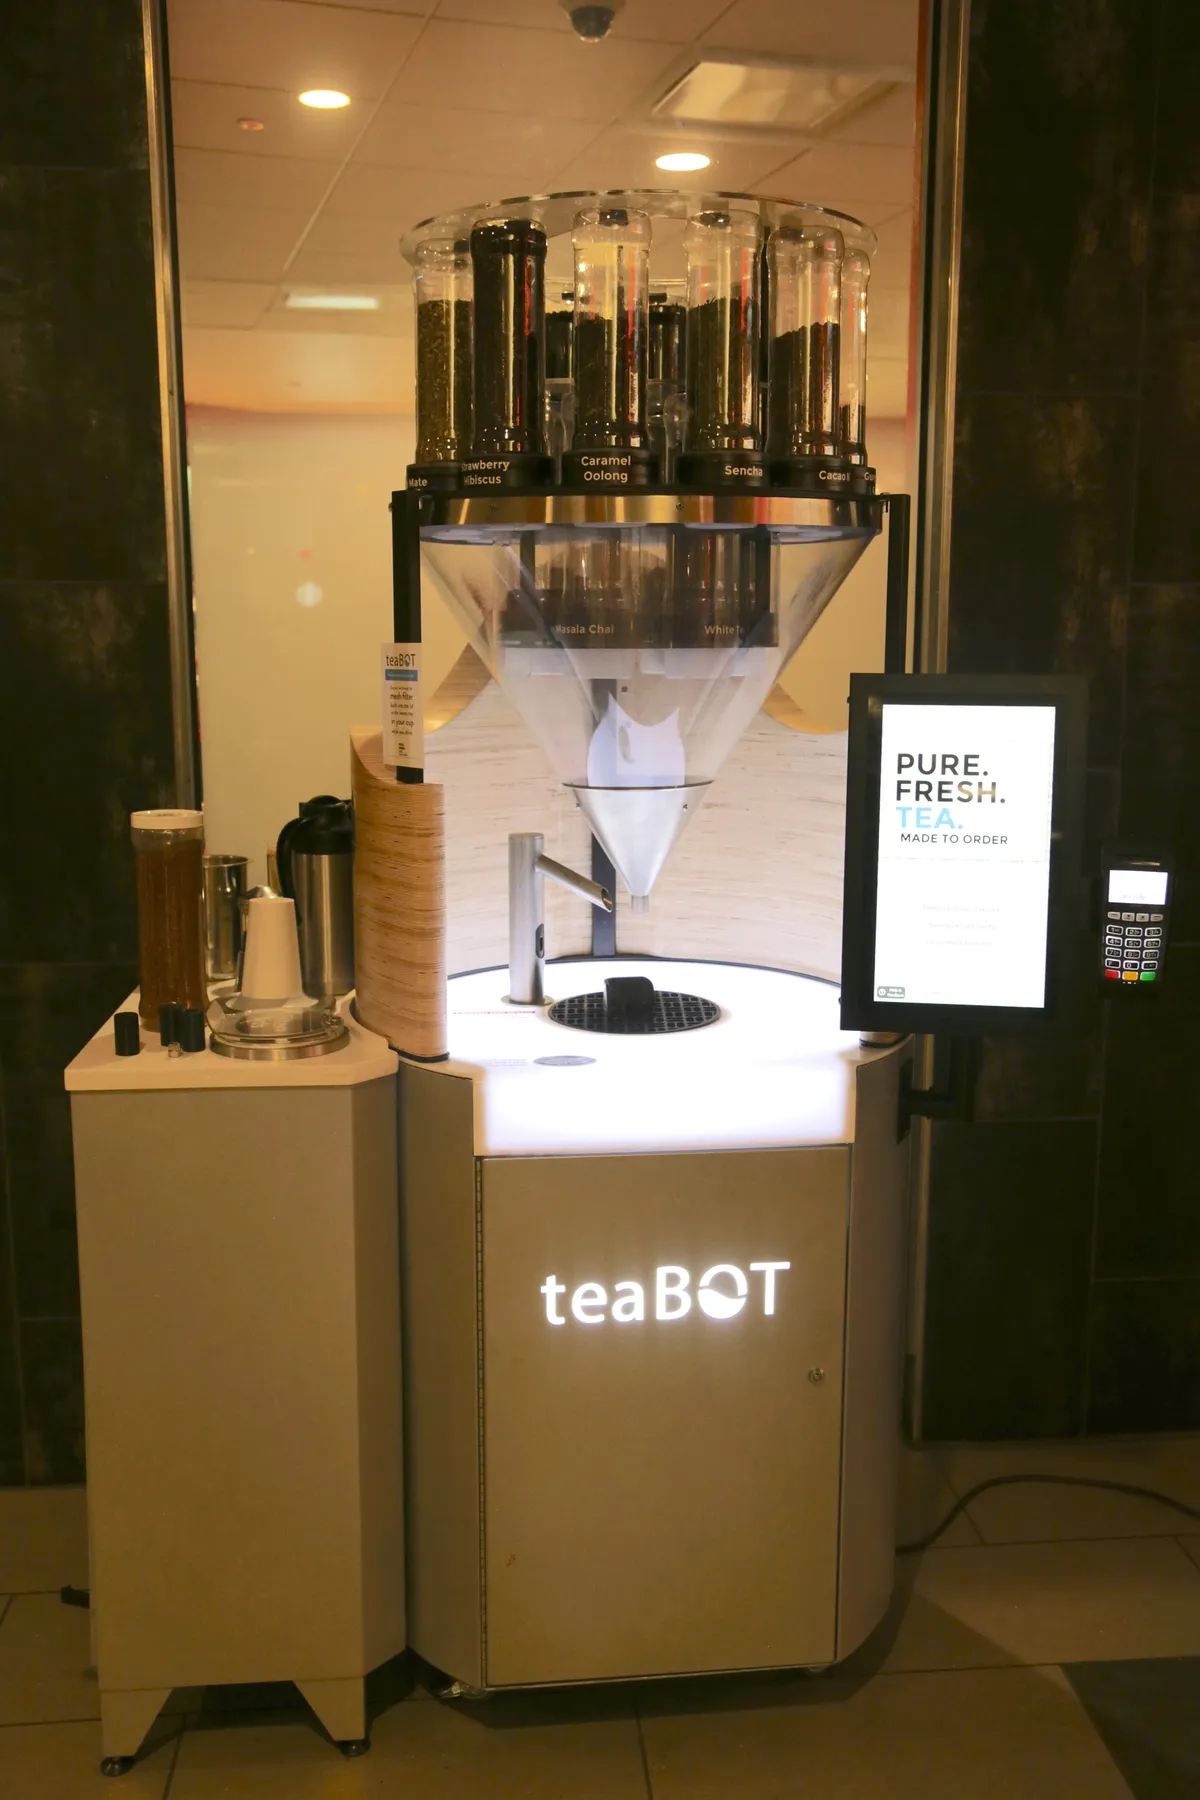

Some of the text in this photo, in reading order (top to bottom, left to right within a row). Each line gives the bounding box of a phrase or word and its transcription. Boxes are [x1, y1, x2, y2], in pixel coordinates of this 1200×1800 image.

[580, 456, 631, 466] Caramel
[583, 470, 628, 483] Oolong
[724, 465, 763, 477] Sencha
[818, 470, 846, 481] Cacao
[408, 477, 428, 488] Mate
[555, 624, 615, 634] Masala Chai
[704, 624, 735, 635] White
[386, 653, 416, 667] teaBOT
[897, 753, 988, 776] PURE.
[896, 780, 1006, 804] FRESH.
[896, 806, 964, 830] TEA.
[900, 833, 1008, 845] MADE TO ORDER
[540, 1261, 791, 1325] teaBOT
